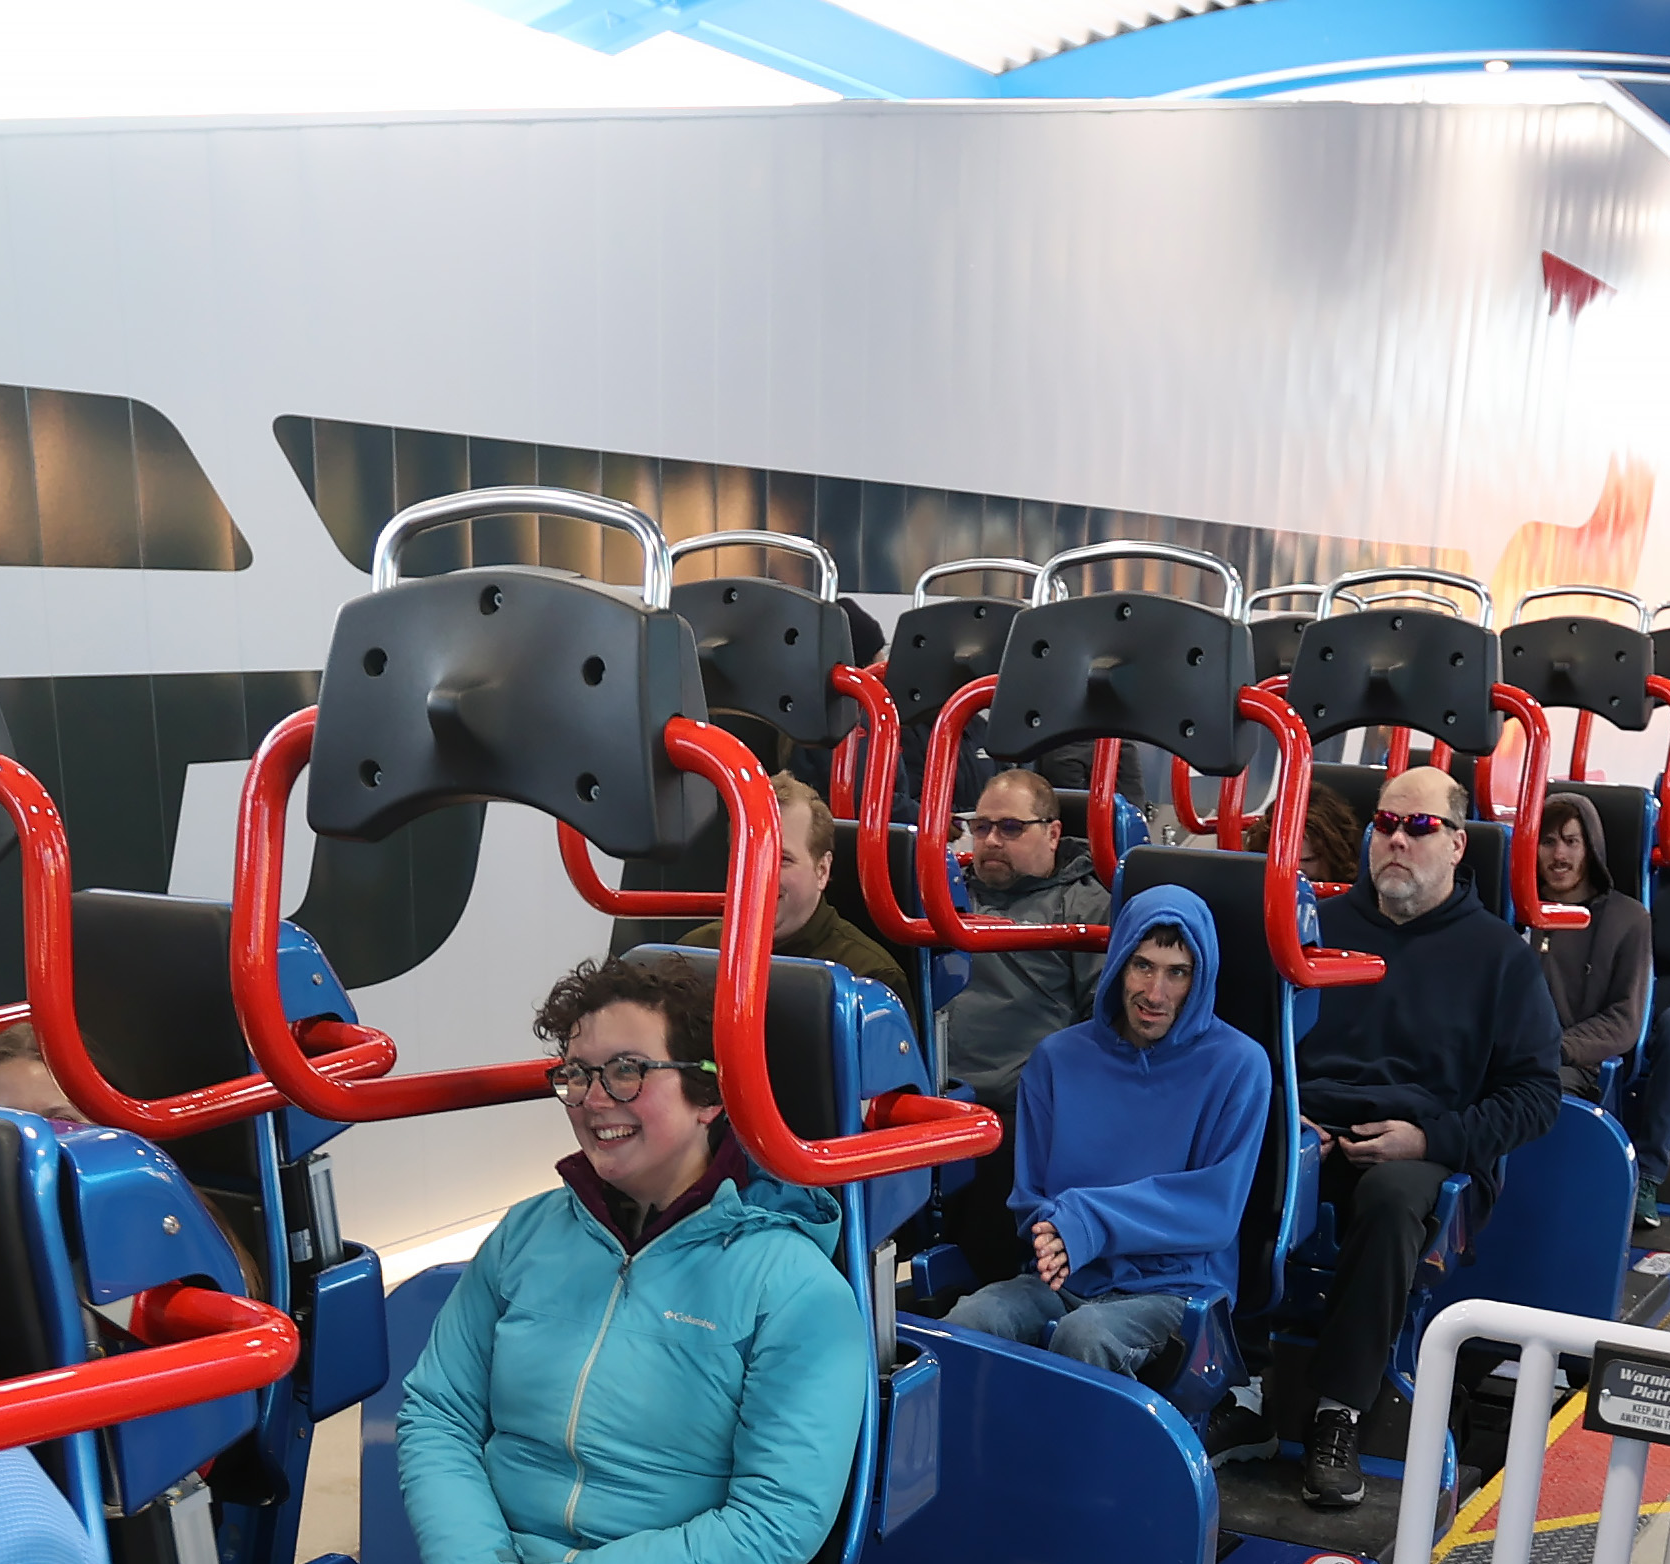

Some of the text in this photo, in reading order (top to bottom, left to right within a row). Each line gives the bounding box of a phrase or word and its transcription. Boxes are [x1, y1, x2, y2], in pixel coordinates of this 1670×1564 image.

[674, 1311, 718, 1331] Columbia
[1632, 1404, 1650, 1414] KEEP
[1652, 1407, 1666, 1417] ALL
[1620, 1412, 1640, 1423] AWAY
[1642, 1416, 1663, 1427] FROM
